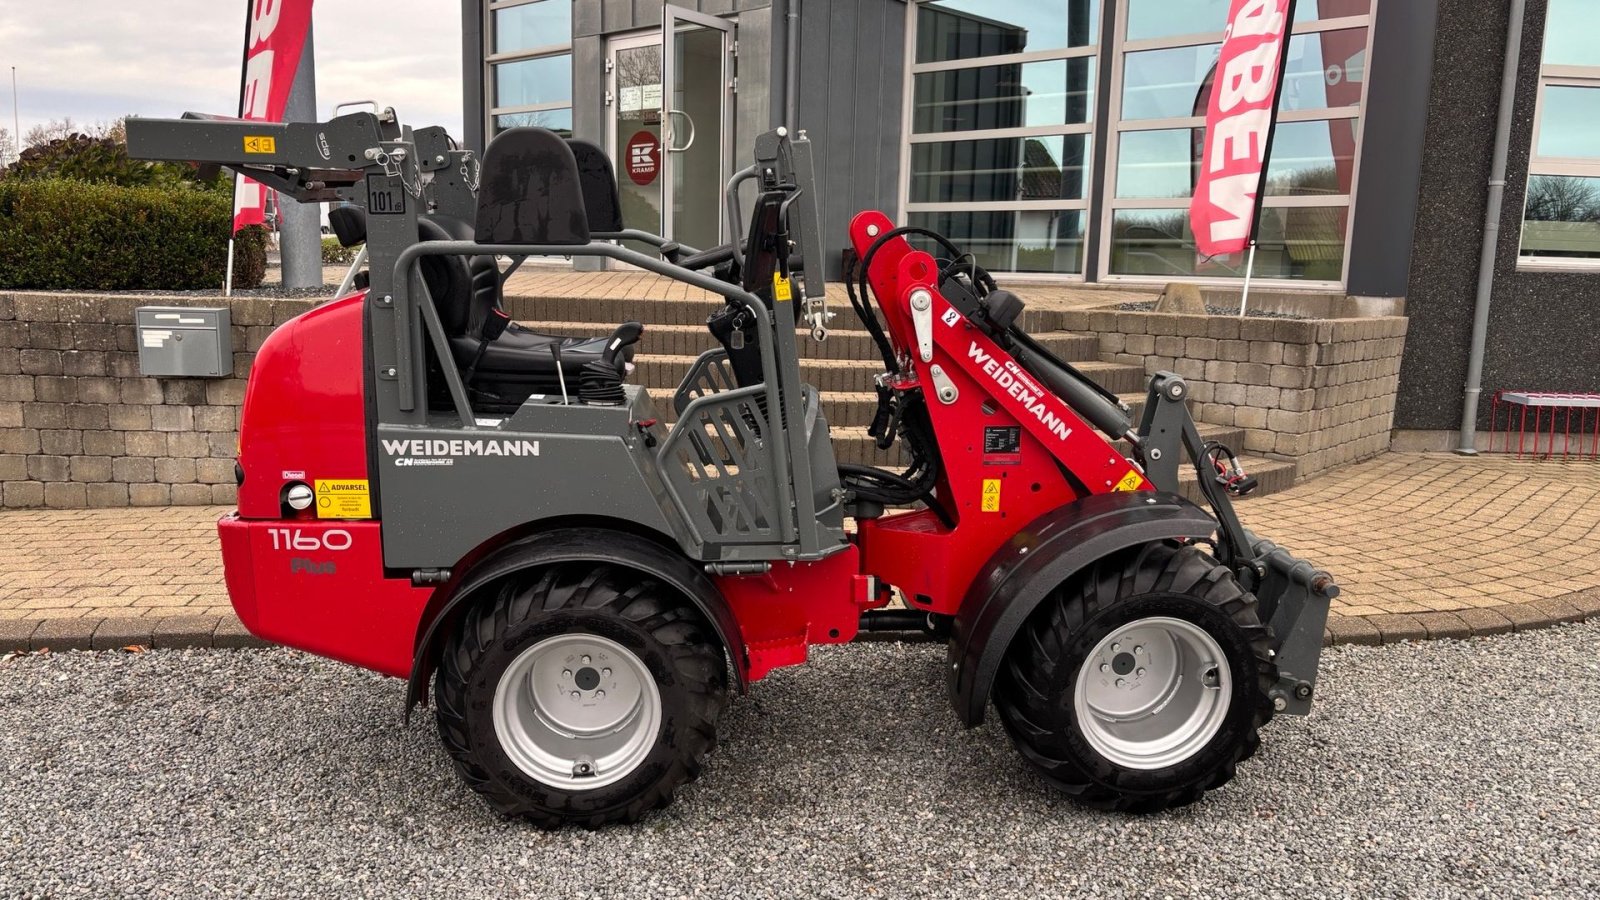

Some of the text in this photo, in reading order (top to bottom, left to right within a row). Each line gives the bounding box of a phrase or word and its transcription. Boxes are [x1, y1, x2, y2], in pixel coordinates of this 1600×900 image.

[631, 166, 655, 174] KRAMP
[371, 191, 393, 211] 101
[1004, 360, 1021, 375] CN
[967, 340, 1073, 442] WEIDEMANN
[381, 439, 540, 457] WEIDEMANN
[394, 457, 414, 467] CN
[267, 529, 353, 551] 1160
[291, 557, 337, 575] Plus
